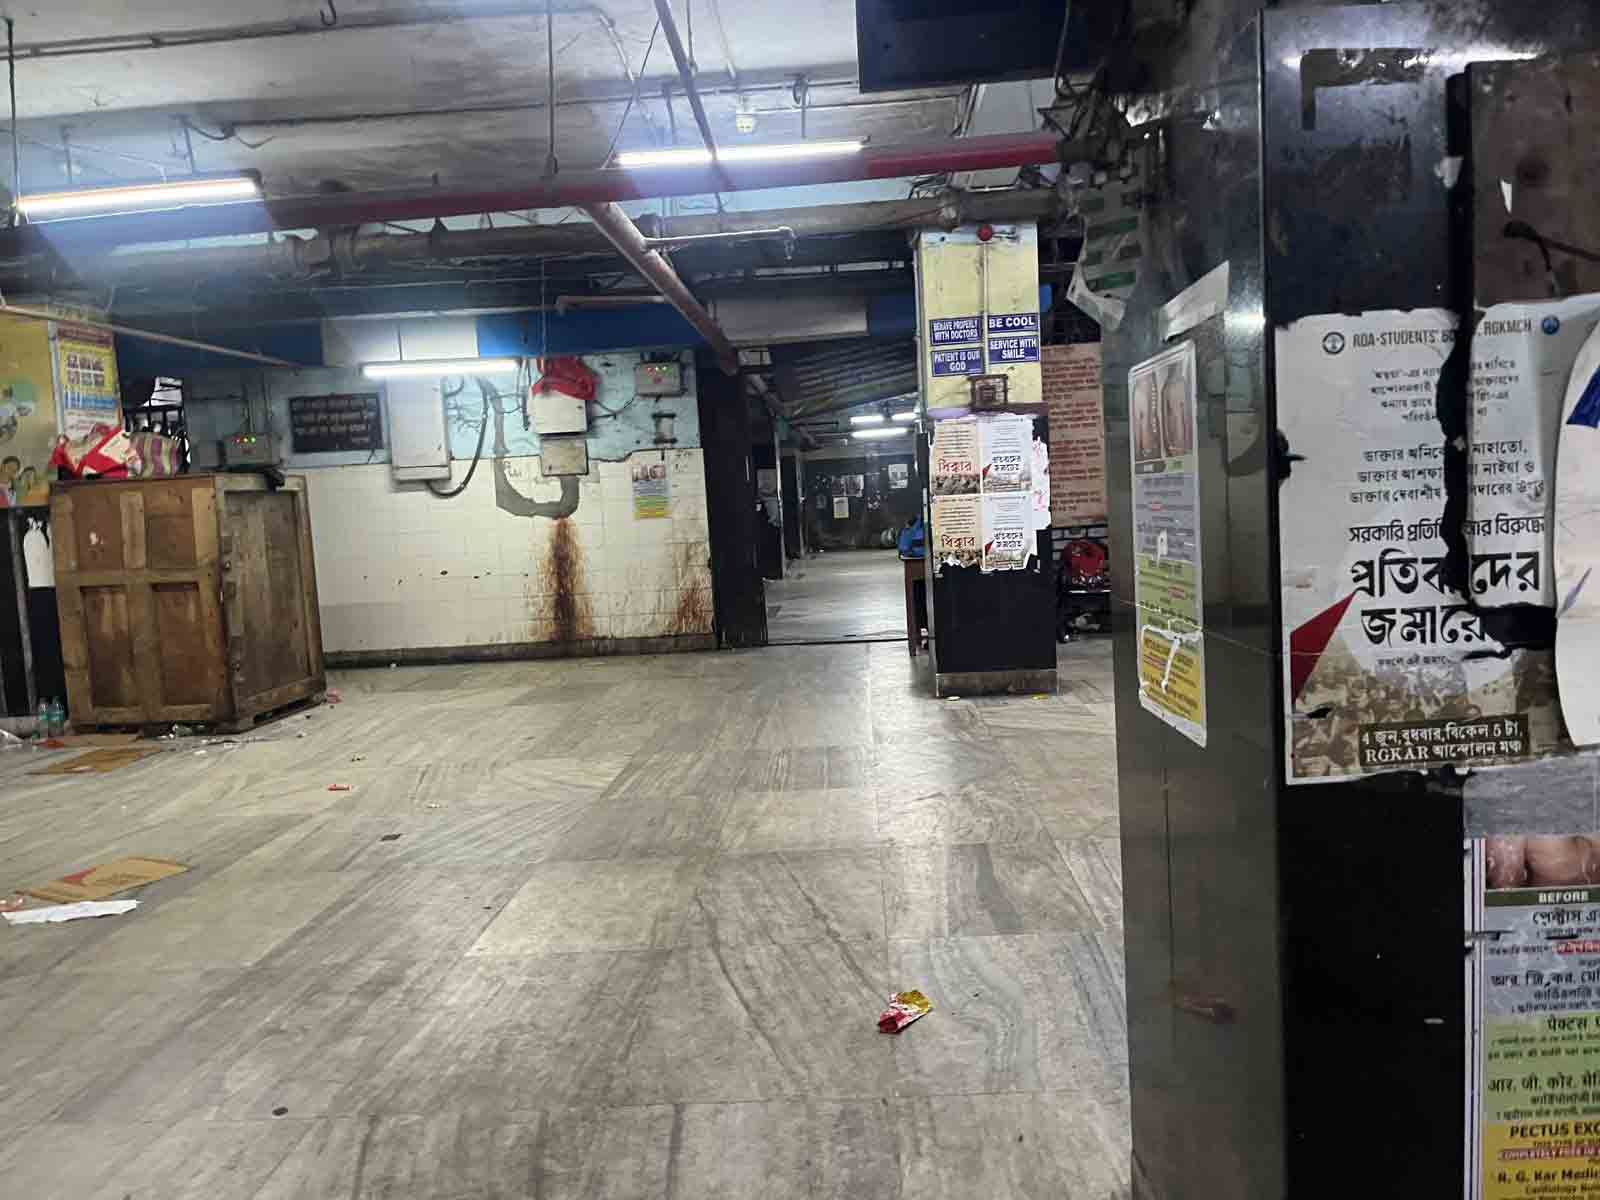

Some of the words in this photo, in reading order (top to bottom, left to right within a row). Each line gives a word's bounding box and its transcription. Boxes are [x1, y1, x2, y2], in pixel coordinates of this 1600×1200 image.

[933, 321, 953, 331] BEHAVE
[953, 319, 978, 330] PROPERLY
[989, 318, 1004, 328] BE
[1006, 316, 1035, 327] COOL
[1484, 320, 1531, 336] RGKMCH
[935, 330, 950, 341] WITH
[951, 328, 978, 340] DOCTORS
[990, 338, 1018, 350] SERVICE
[1020, 337, 1037, 349] WITH
[934, 350, 959, 362] PATIENT
[960, 350, 967, 361] IS
[968, 349, 981, 360] OUR
[1002, 347, 1025, 360] SMILE
[949, 361, 967, 372] GOD
[1349, 519, 1404, 544] সরকারি
[1366, 746, 1429, 763] RGKAR
[1538, 891, 1589, 903] BEFORE
[1510, 1123, 1569, 1138] PECTUS
[1534, 1168, 1557, 1181] Kar
